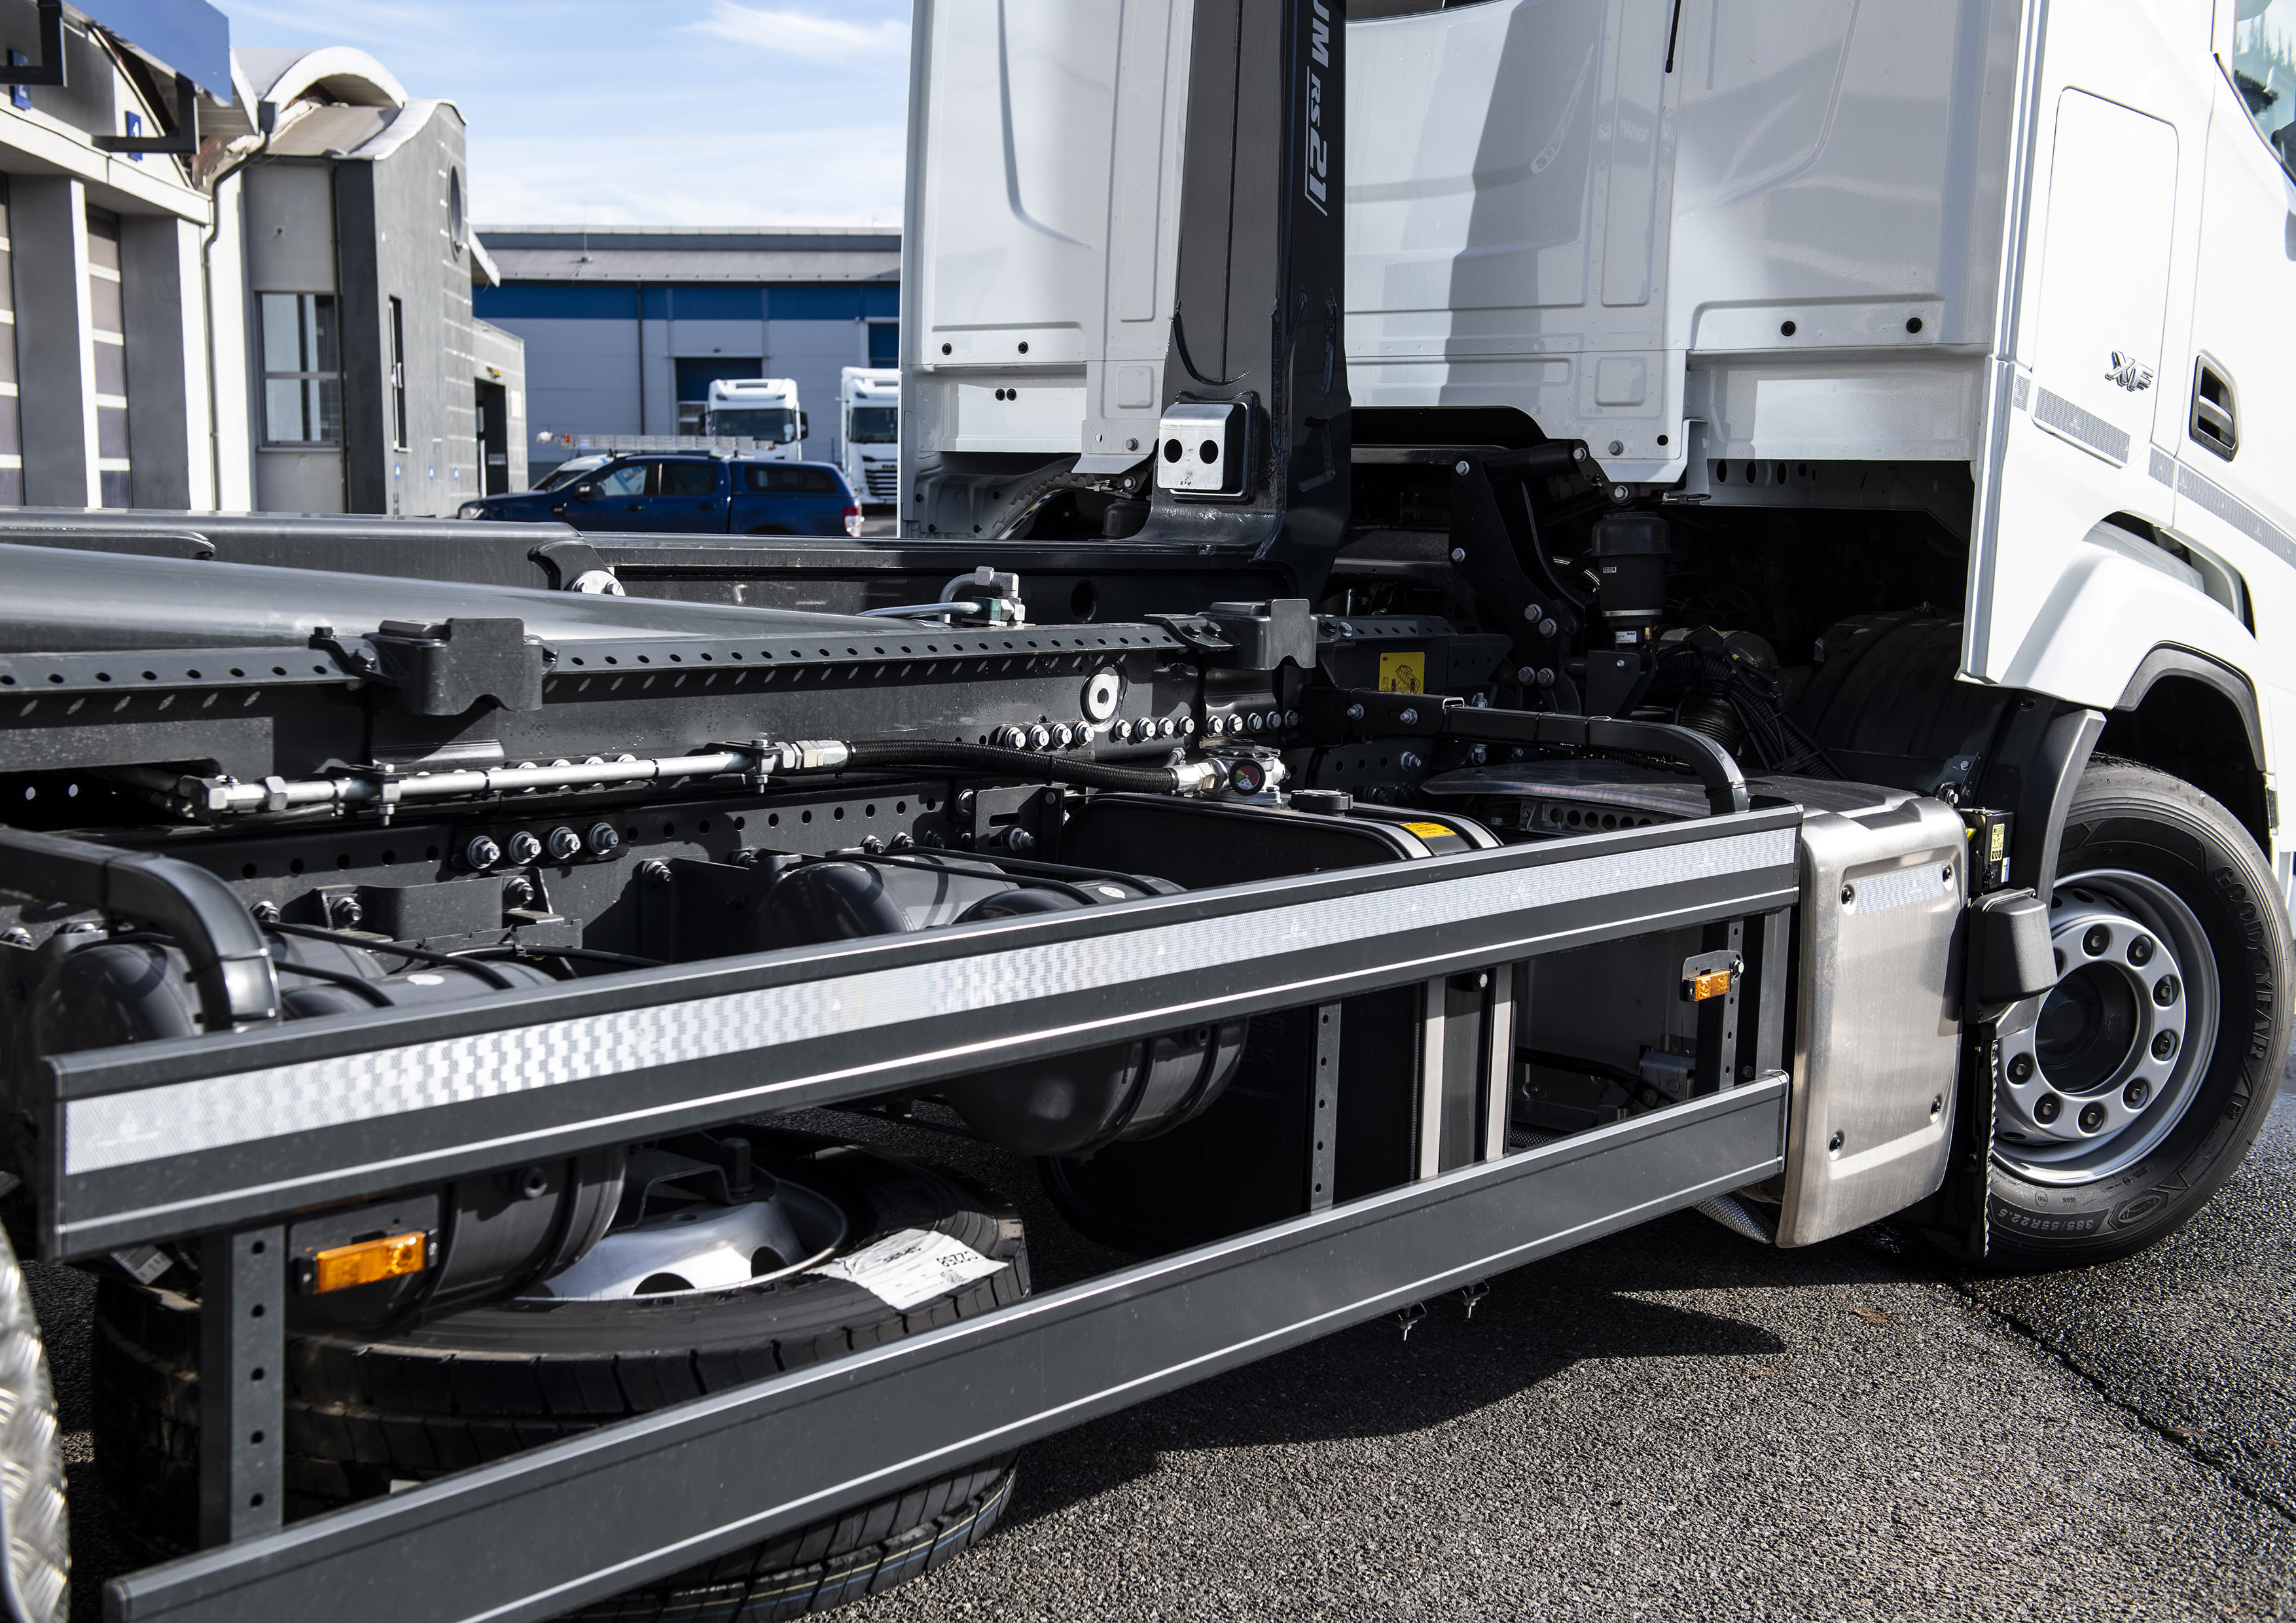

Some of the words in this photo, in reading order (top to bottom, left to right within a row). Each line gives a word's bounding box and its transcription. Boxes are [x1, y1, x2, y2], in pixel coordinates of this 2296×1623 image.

[1311, 73, 1321, 127] RS
[1310, 126, 1327, 202] 21
[2105, 350, 2154, 392] XF
[1998, 1209, 2094, 1231] 385/55R22.5
